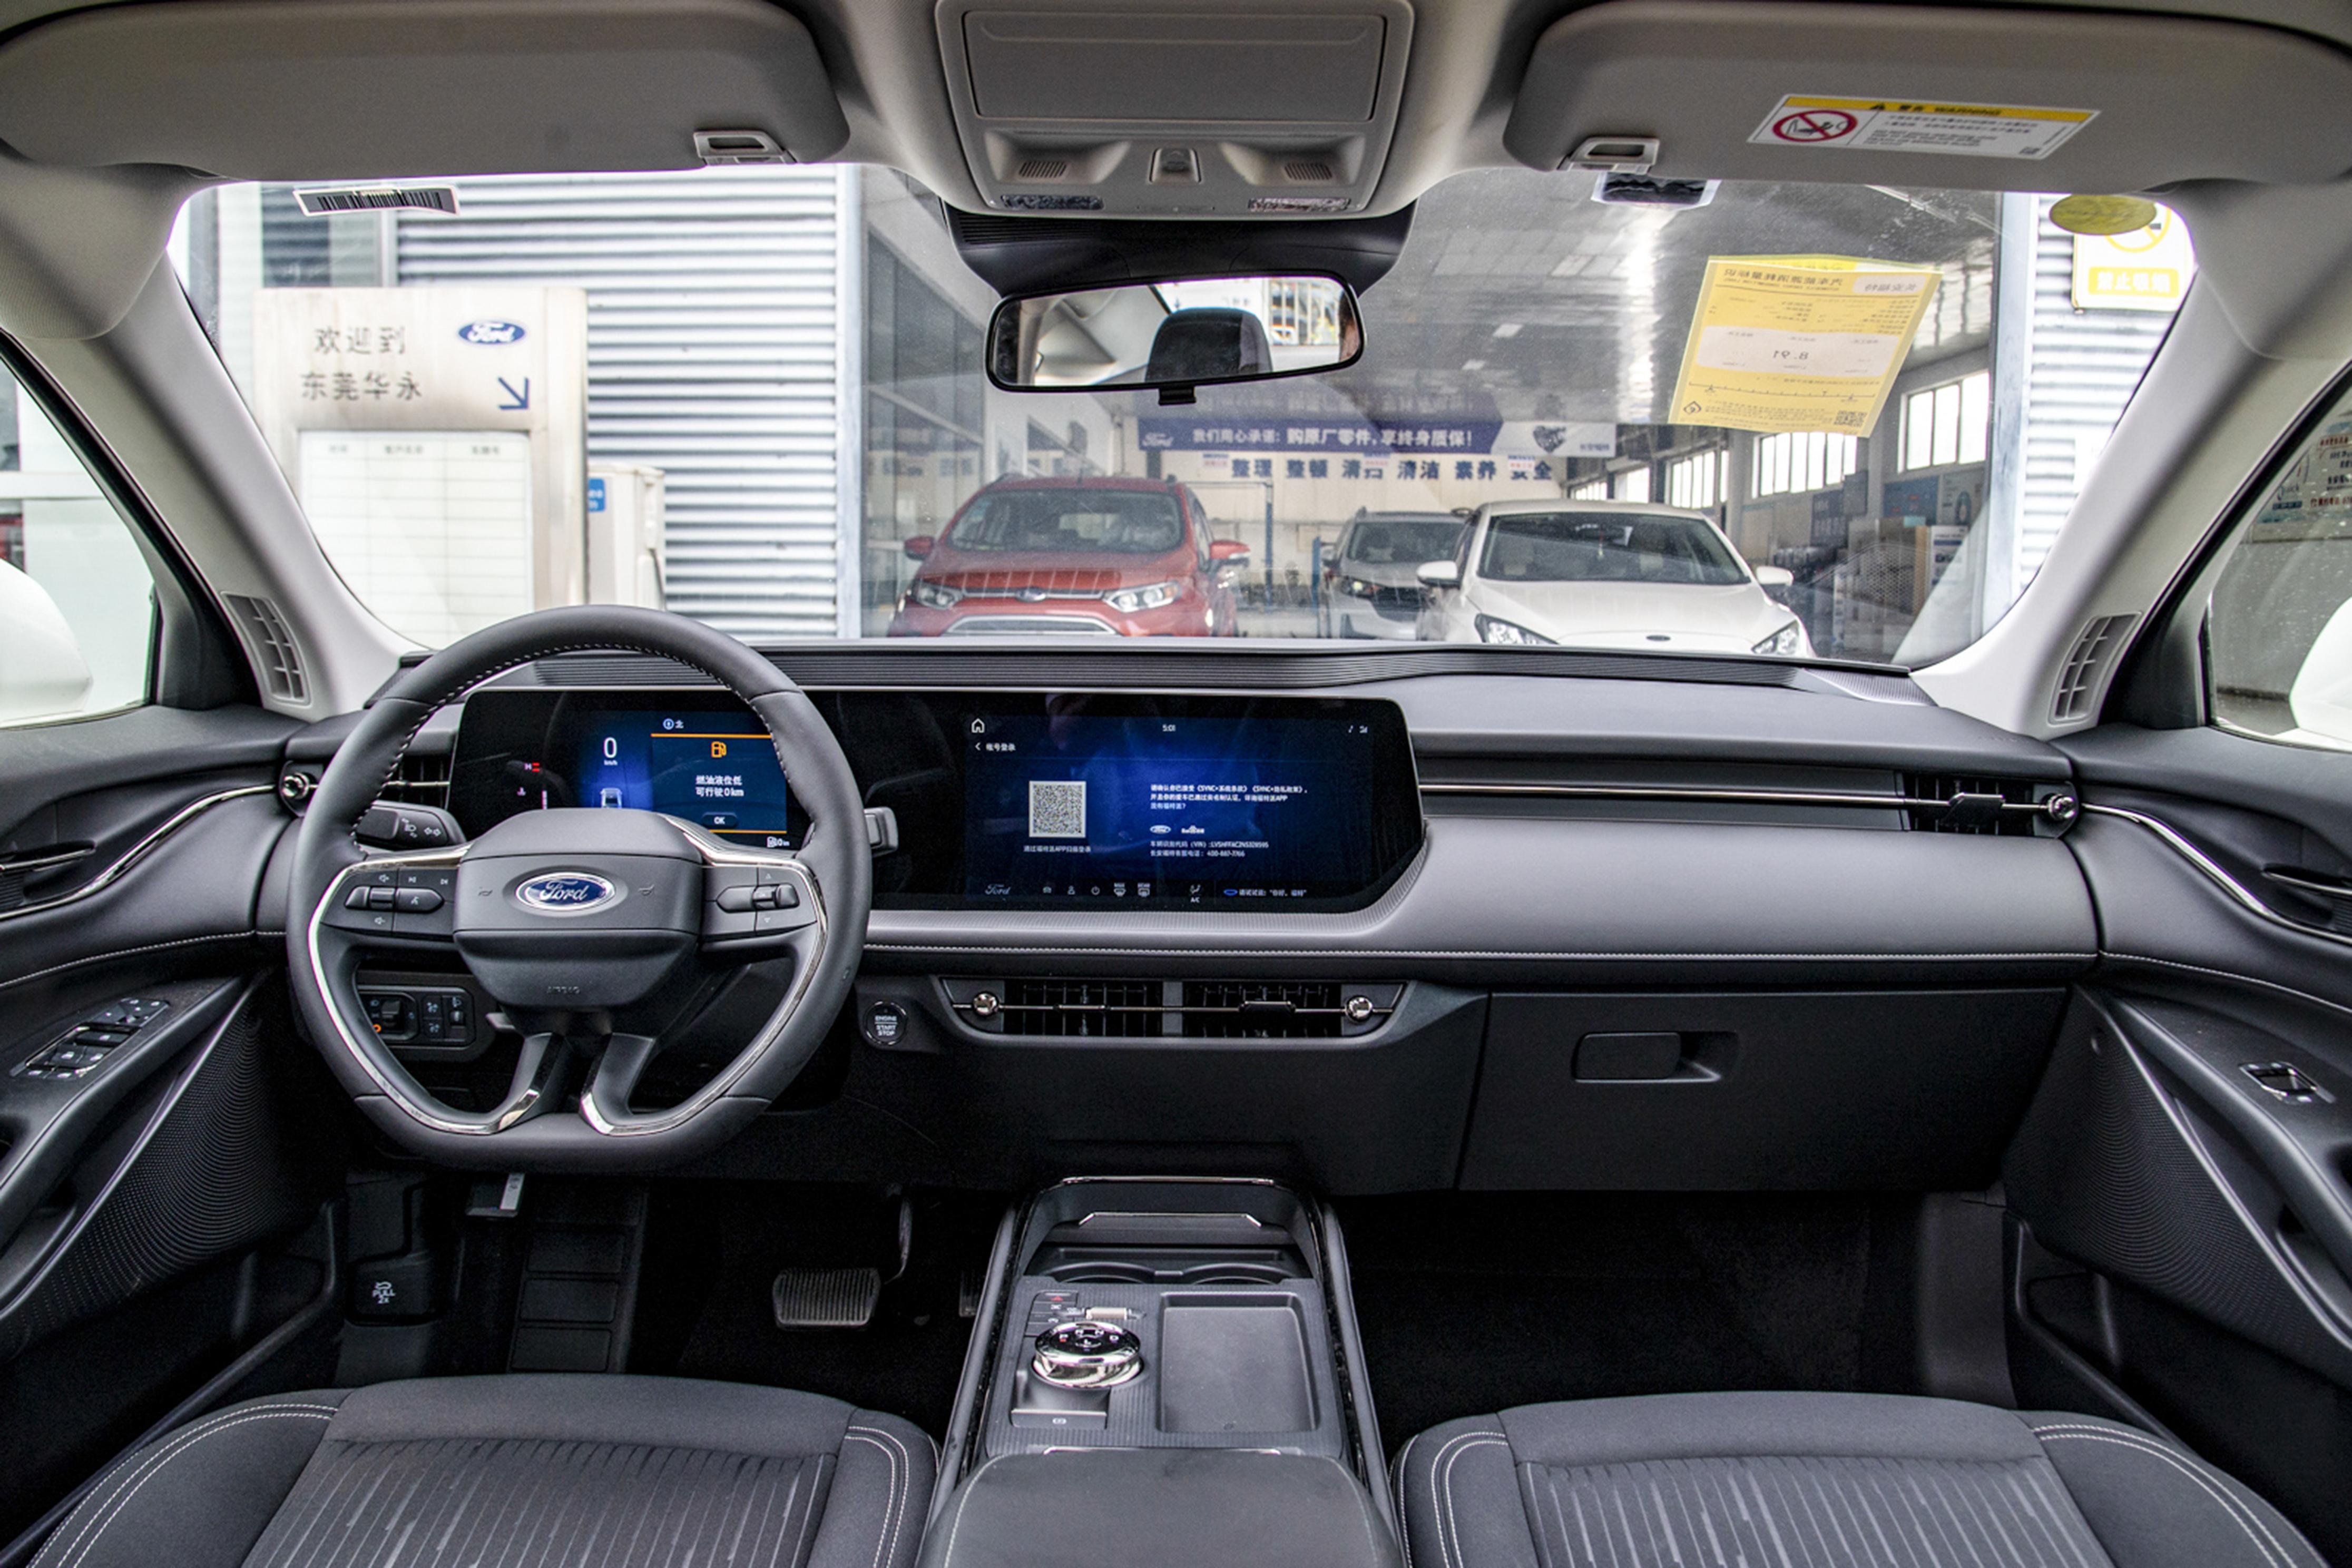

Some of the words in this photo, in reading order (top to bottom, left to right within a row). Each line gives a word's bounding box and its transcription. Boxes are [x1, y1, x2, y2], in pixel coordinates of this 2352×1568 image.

[314, 326, 406, 355] 欢迎到
[466, 321, 518, 345] Ford
[300, 371, 422, 401] 东莞华永
[1232, 458, 1272, 478] 整理
[1287, 458, 1328, 478] 整顿
[1397, 460, 1439, 480] 清洁
[1455, 460, 1496, 480] 素养
[603, 737, 617, 758] 0
[695, 775, 742, 786] 燃油液位低
[539, 879, 590, 901] Ford
[984, 883, 1011, 895] Ford
